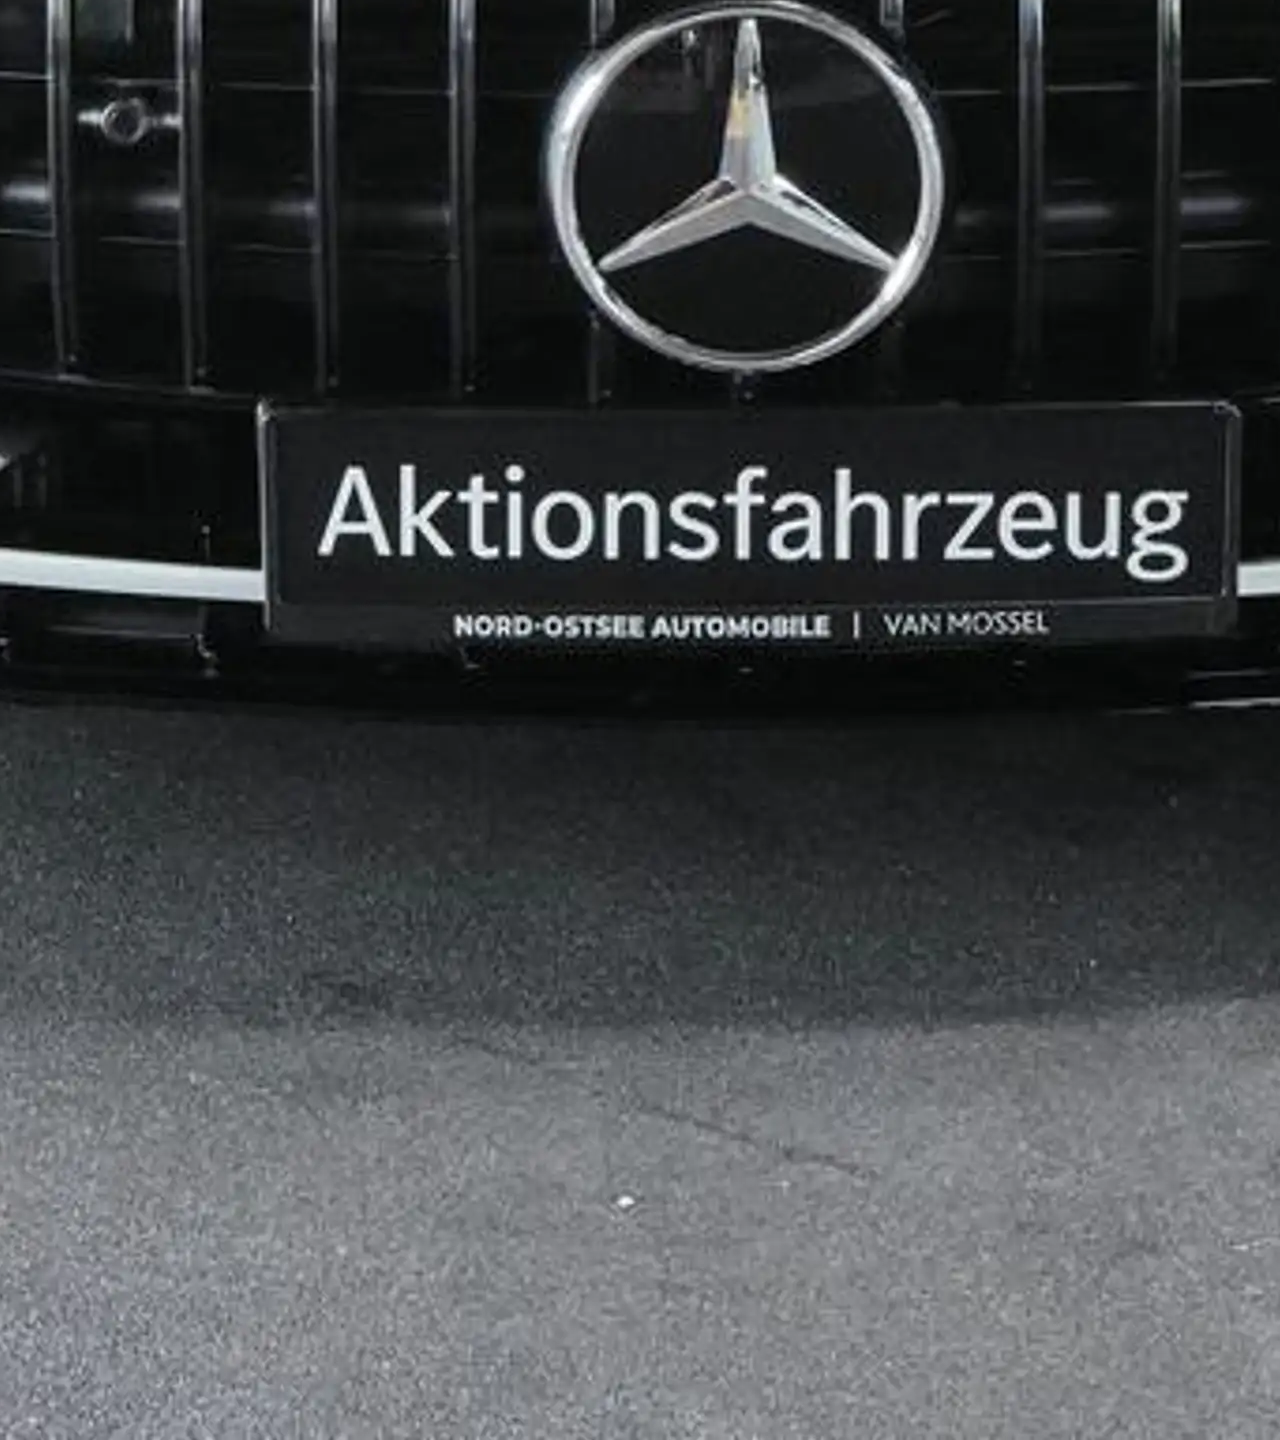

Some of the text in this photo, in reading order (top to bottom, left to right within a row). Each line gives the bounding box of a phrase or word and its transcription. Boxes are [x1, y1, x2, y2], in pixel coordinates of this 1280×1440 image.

[318, 464, 1190, 582] Aktionsfahrzeug
[650, 614, 832, 639] AUTOMOBILE
[883, 613, 942, 637] VAN
[946, 610, 1050, 636] MOSSEL
